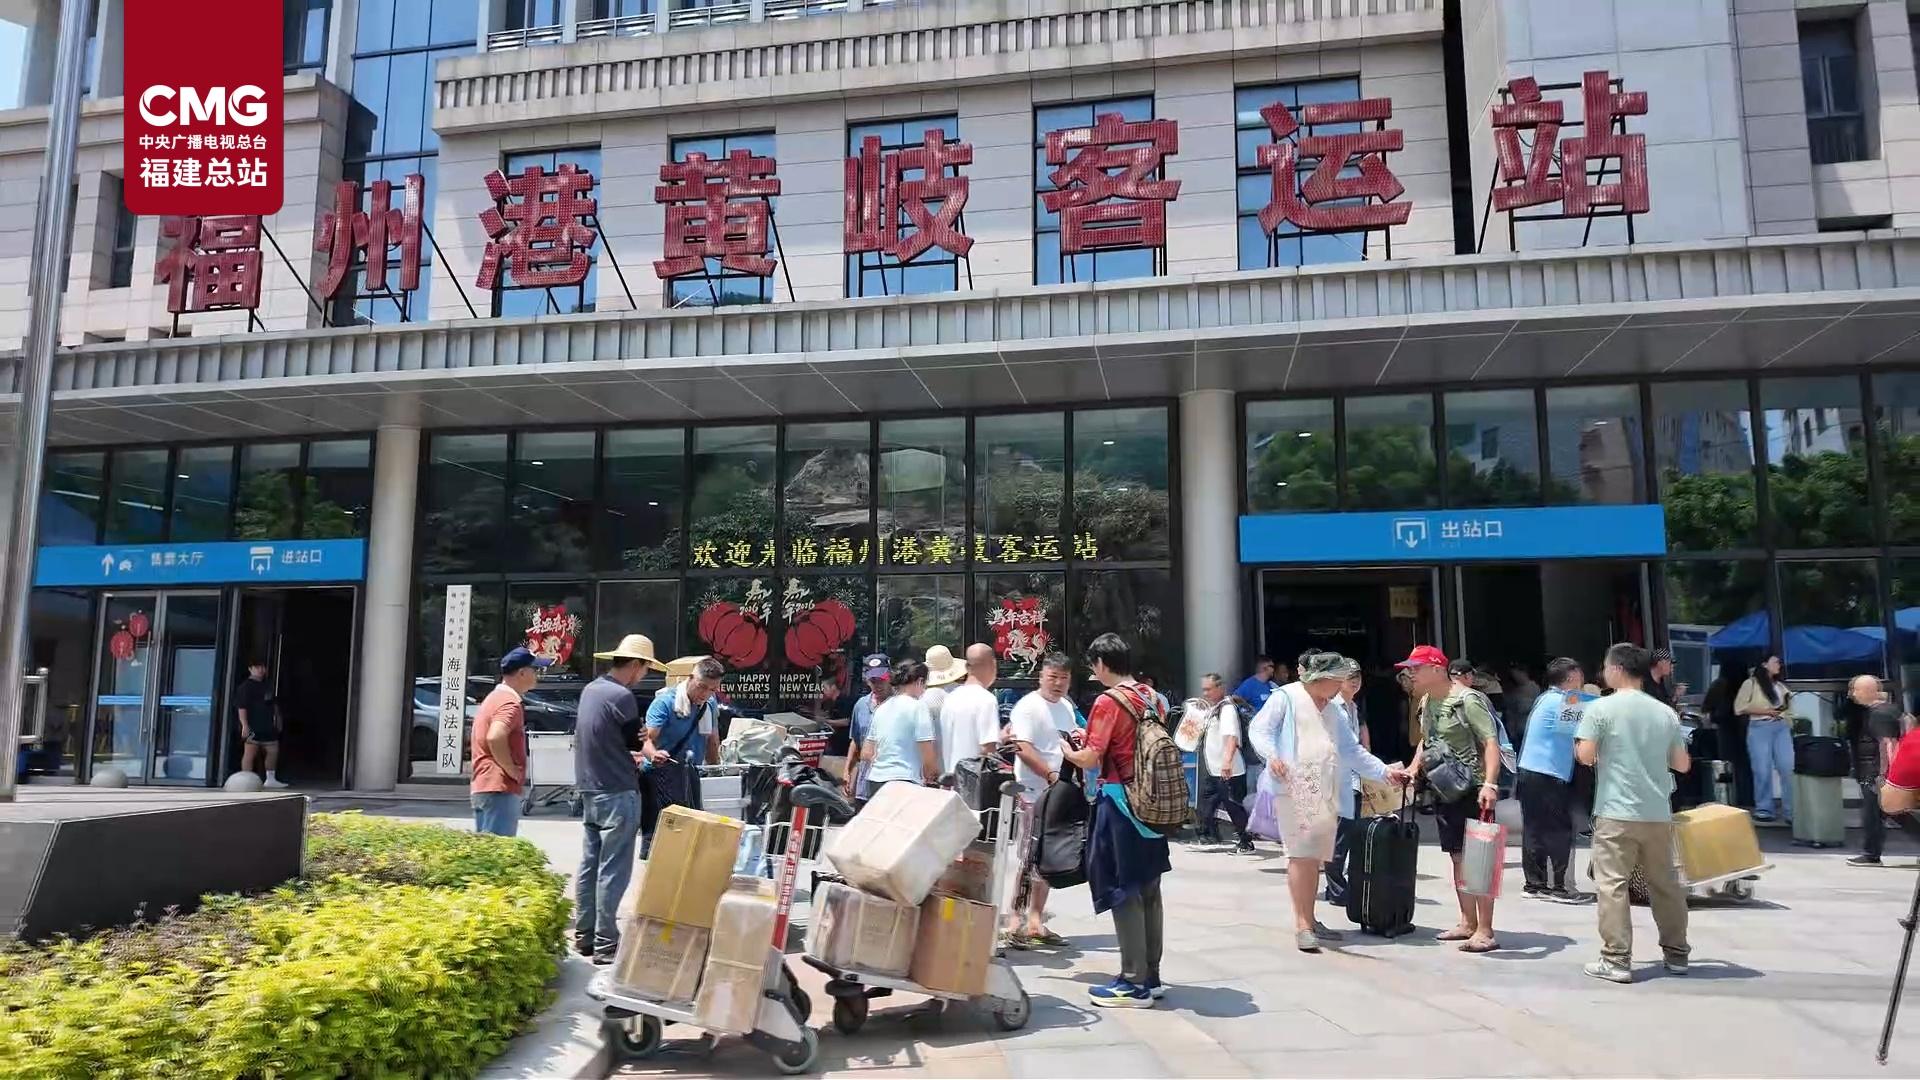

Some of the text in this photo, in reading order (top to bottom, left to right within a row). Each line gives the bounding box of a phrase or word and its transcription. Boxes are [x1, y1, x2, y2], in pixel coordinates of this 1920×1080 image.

[155, 71, 1651, 313] 福州港黄岐客运站
[1441, 520, 1503, 538] 出站口
[151, 551, 205, 567] 售票大厅
[281, 549, 323, 564] 进站口
[739, 673, 771, 682] HAPPY
[779, 673, 811, 682] HAPPY
[720, 683, 770, 692] EW YEAR'S
[779, 683, 801, 692] NEW
[442, 657, 462, 768] 海巡执法支队
